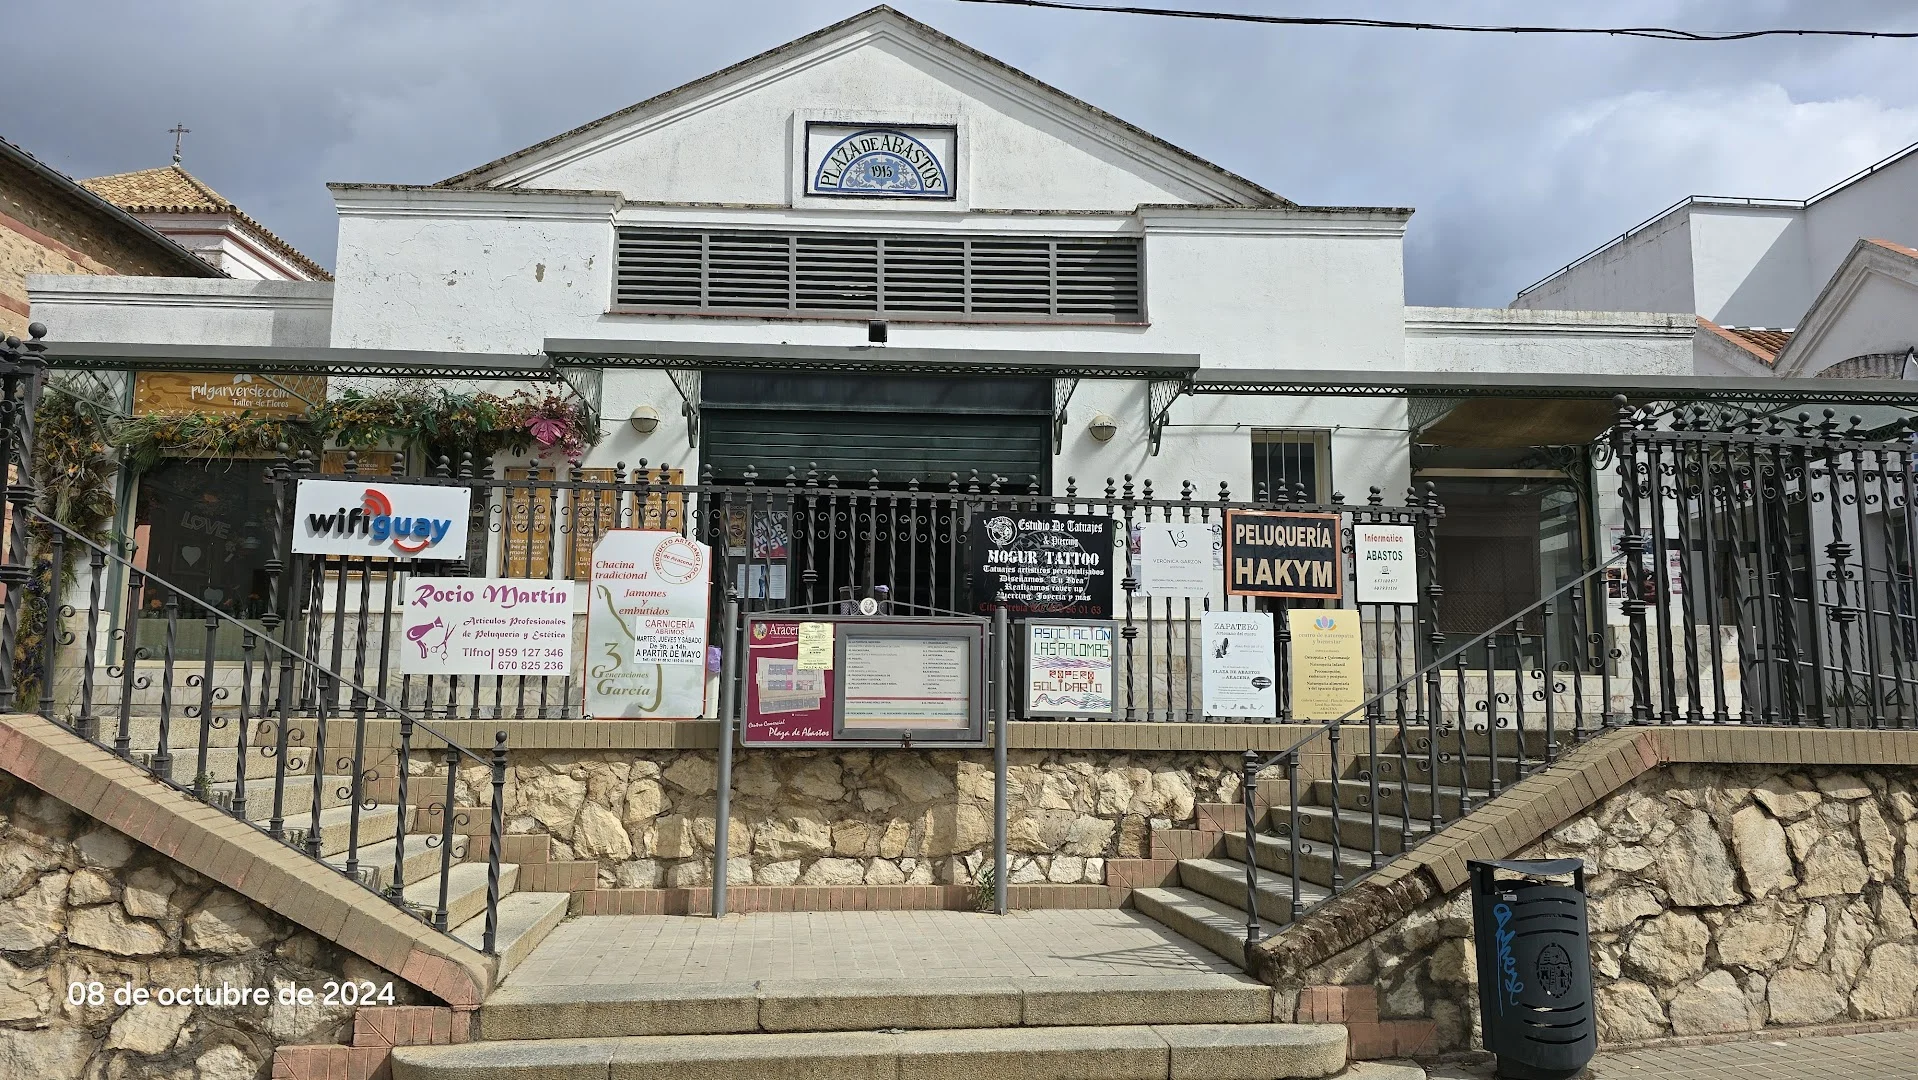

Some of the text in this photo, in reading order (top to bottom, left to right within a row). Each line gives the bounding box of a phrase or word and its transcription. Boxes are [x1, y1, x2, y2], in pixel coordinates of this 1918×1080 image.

[820, 134, 942, 189] PLAZA DE ABASTOS
[871, 165, 893, 178] 1915
[191, 382, 290, 400] pulgarverde.com
[232, 399, 289, 408] Taller de Flores
[181, 511, 231, 540] LOVE
[309, 507, 452, 544] wifiguay
[1018, 519, 1103, 535] Estudio De Tatuajes
[1235, 522, 1332, 548] PELUQUERÍA
[1051, 536, 1079, 547] Piercing
[654, 538, 701, 580] PRODUCTO ARTESANO LOCAL
[1045, 551, 1100, 566] TATTOO
[1366, 550, 1403, 561] ABASTOS
[595, 560, 635, 570] Chacina
[982, 565, 1016, 573] Tatuajes
[1052, 567, 1105, 576] personalizados
[595, 571, 648, 580] tradicional
[1235, 557, 1333, 588] HAKYM
[999, 574, 1044, 583] Diseñamos
[624, 589, 667, 598] Jamones
[1004, 583, 1084, 593] Realizamos cover up
[482, 584, 567, 609] Martín
[642, 599, 648, 607] y
[618, 606, 669, 616] embutidos
[509, 616, 566, 627] Profesionales
[645, 619, 695, 629] CARNICERÍA
[1213, 622, 1259, 631] ZAPATERO
[462, 630, 472, 638] de
[523, 631, 528, 640] y
[1034, 626, 1111, 641] ASOCIACIÓN
[636, 635, 658, 643] MARTES,
[681, 636, 702, 644] SÁBADO
[462, 648, 564, 658] Tlfno 959 127 346
[604, 642, 622, 673] 3
[635, 648, 701, 659] A PARTIR DE MAYO
[498, 661, 564, 670] 670 825 236
[591, 664, 649, 679] Generaciones
[1049, 670, 1095, 680] ROPERO
[596, 678, 651, 697] García
[1033, 680, 1103, 693] SOLIDARIO
[768, 727, 830, 740] Plaza de Abastos
